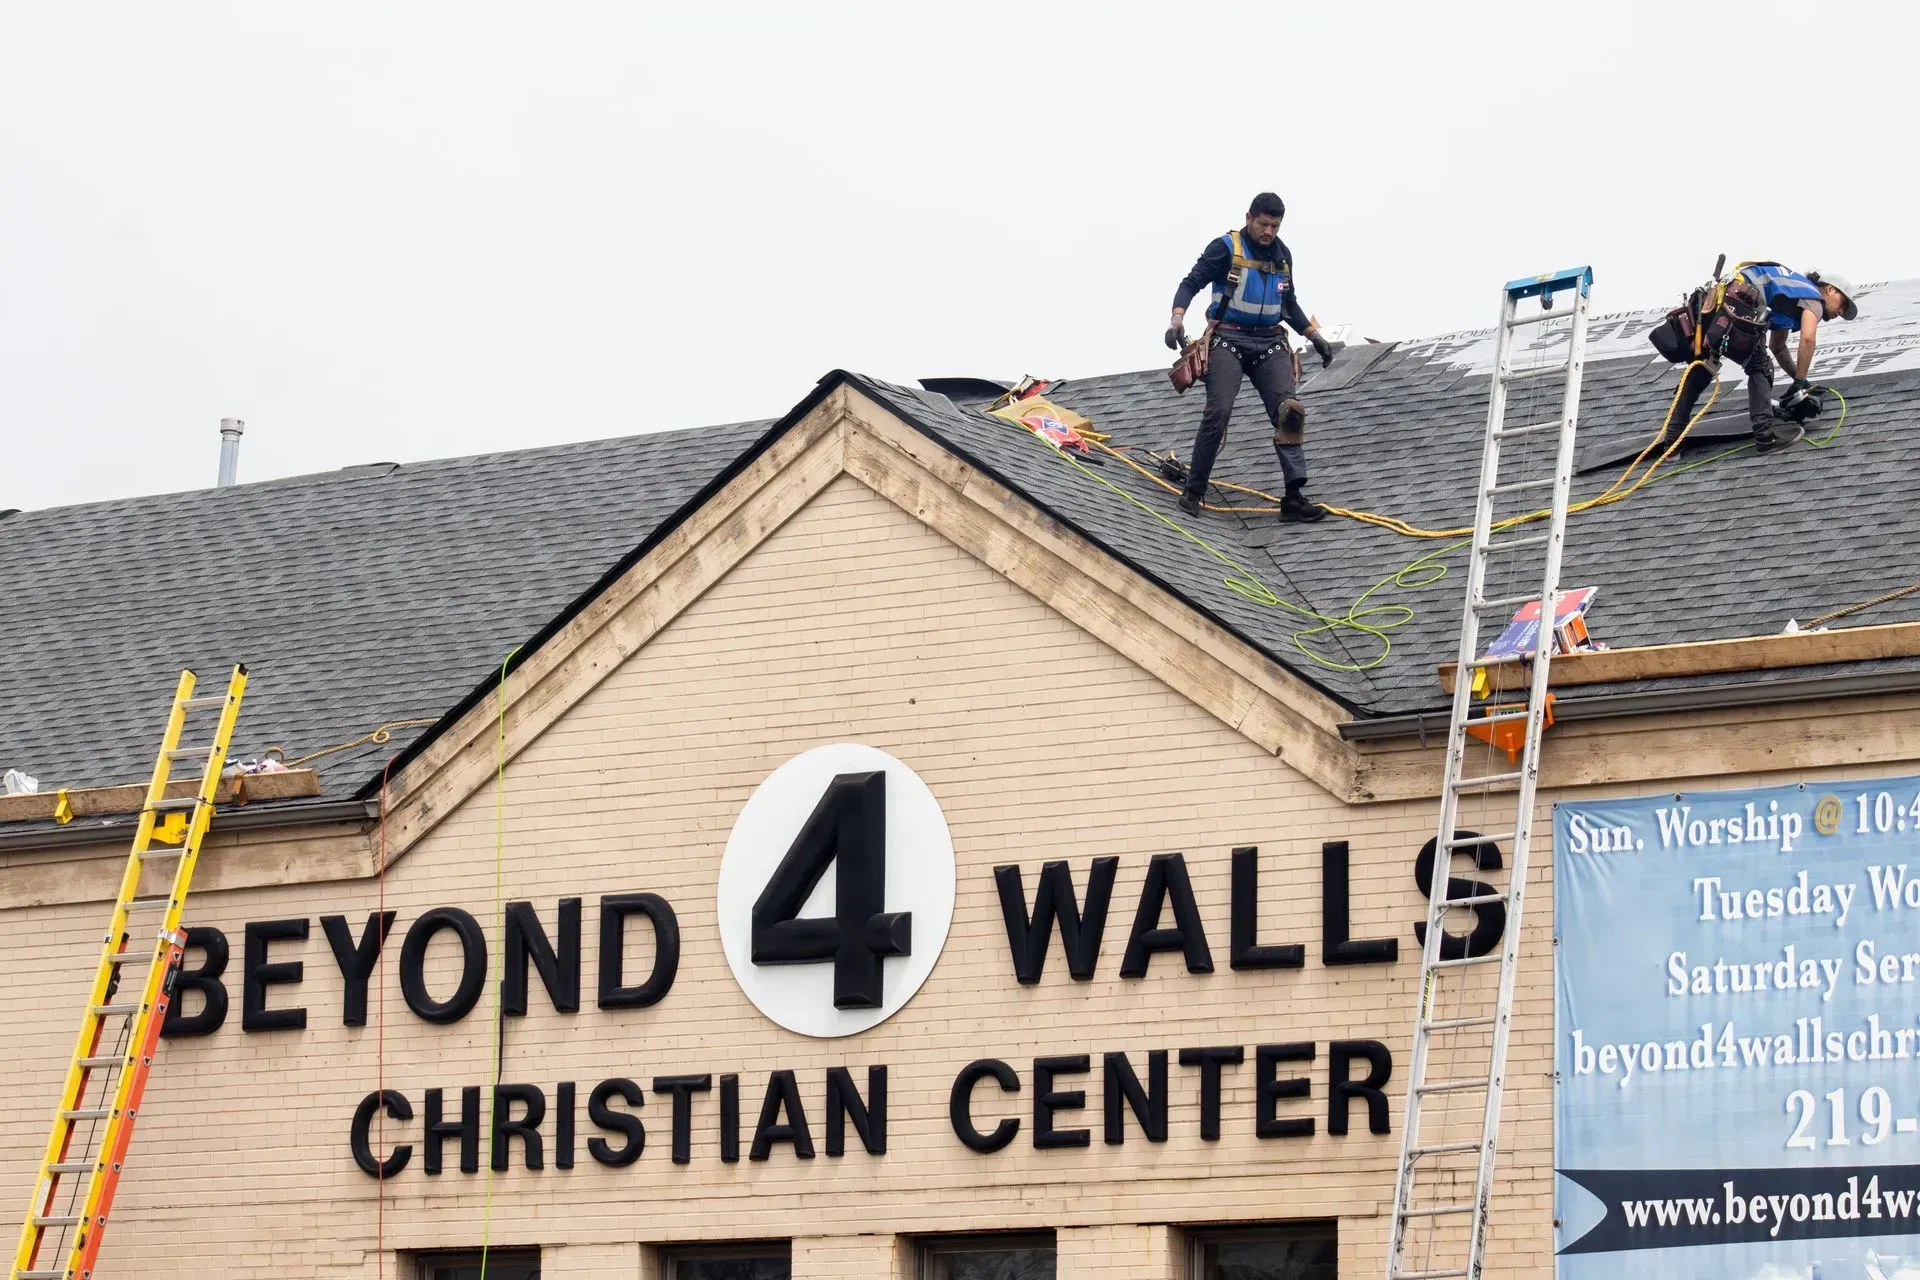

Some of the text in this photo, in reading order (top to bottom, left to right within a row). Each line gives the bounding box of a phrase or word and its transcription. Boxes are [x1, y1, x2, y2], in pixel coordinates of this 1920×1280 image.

[1569, 814, 1644, 854] Sun.
[1656, 799, 1804, 852] Worship
[1814, 794, 1844, 836] @
[159, 770, 1507, 1038] BEYOND 4 WALLS
[1693, 863, 1920, 928] Tuesday Wo
[1667, 939, 1920, 1002] Saturday Ser
[350, 1040, 1393, 1179] CHRISTIAN CENTER
[1621, 1174, 1920, 1237] www.beyond4w
